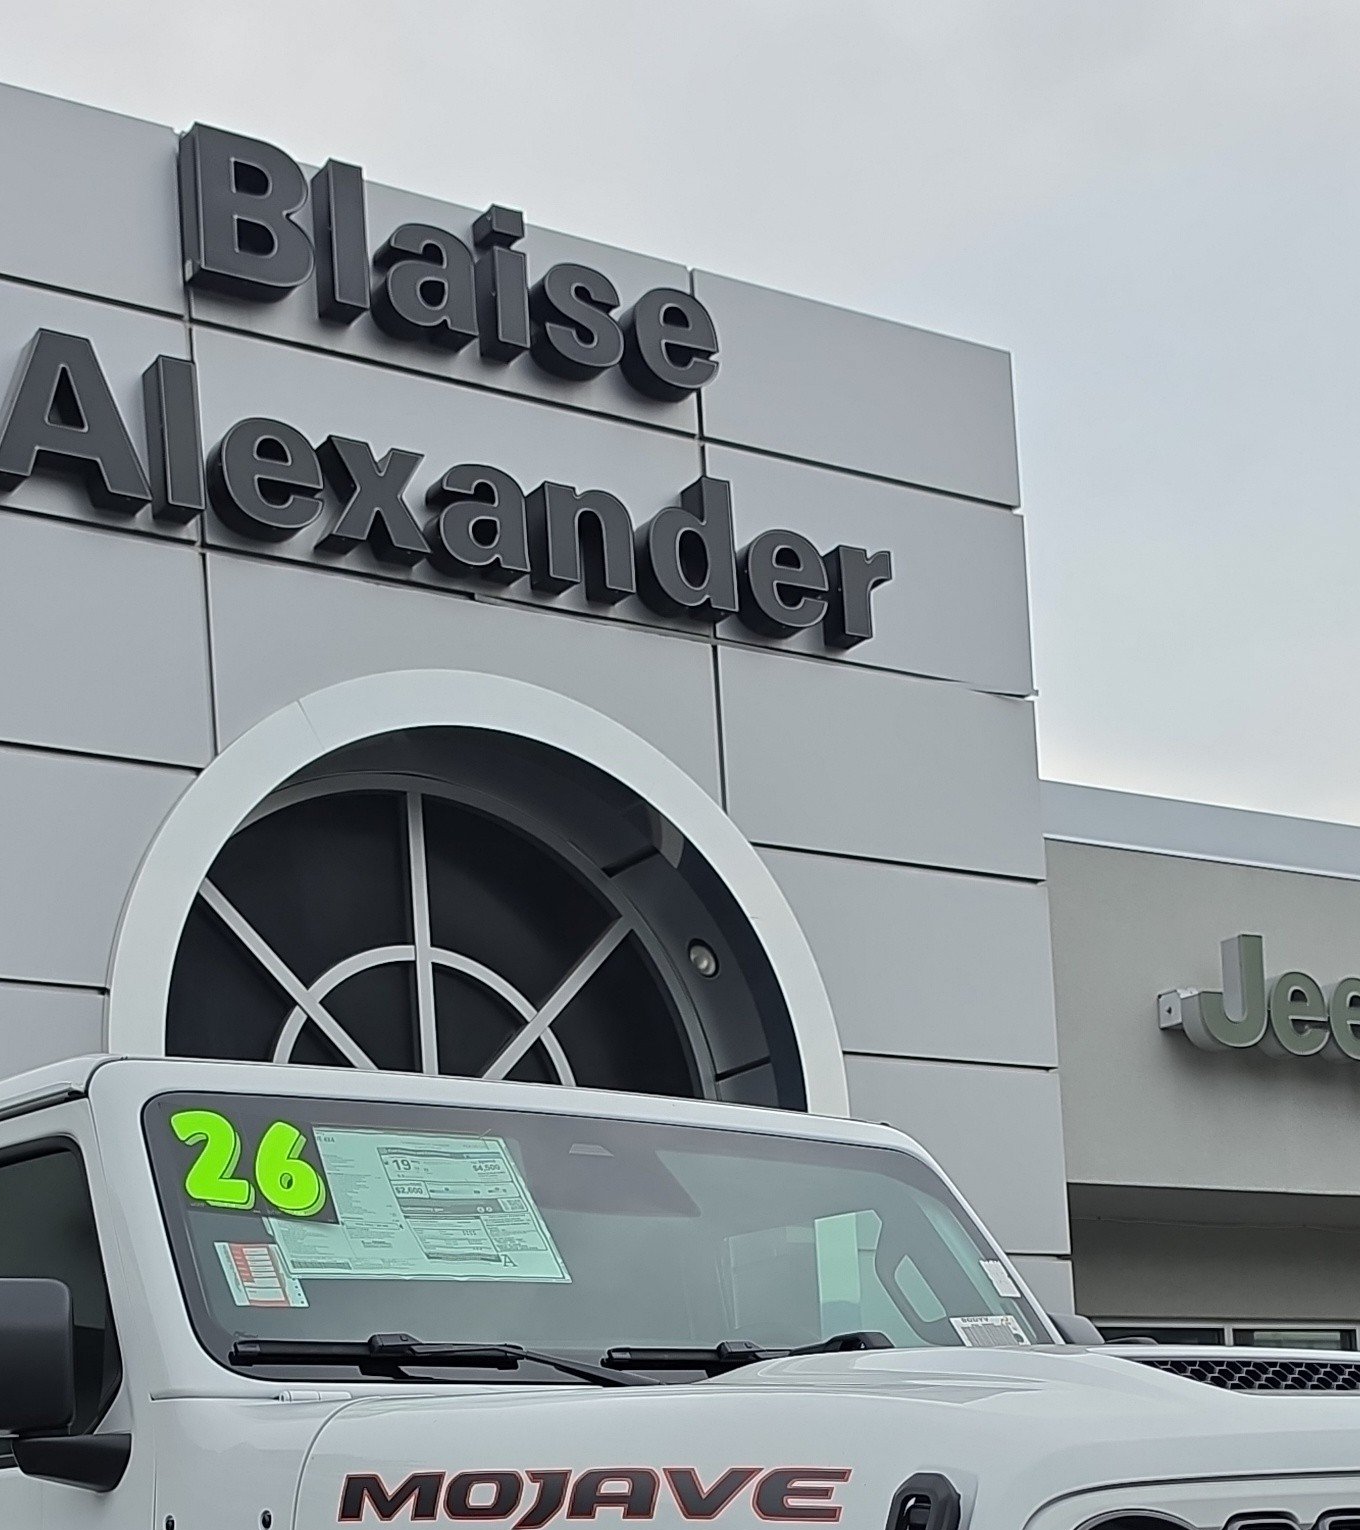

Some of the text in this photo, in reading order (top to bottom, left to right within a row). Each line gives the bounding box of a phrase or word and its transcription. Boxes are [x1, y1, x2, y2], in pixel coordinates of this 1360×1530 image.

[178, 122, 721, 401] Blaise
[170, 1109, 327, 1217] 26
[391, 1159, 412, 1171] 19
[336, 1466, 853, 1530] MOJAVE
